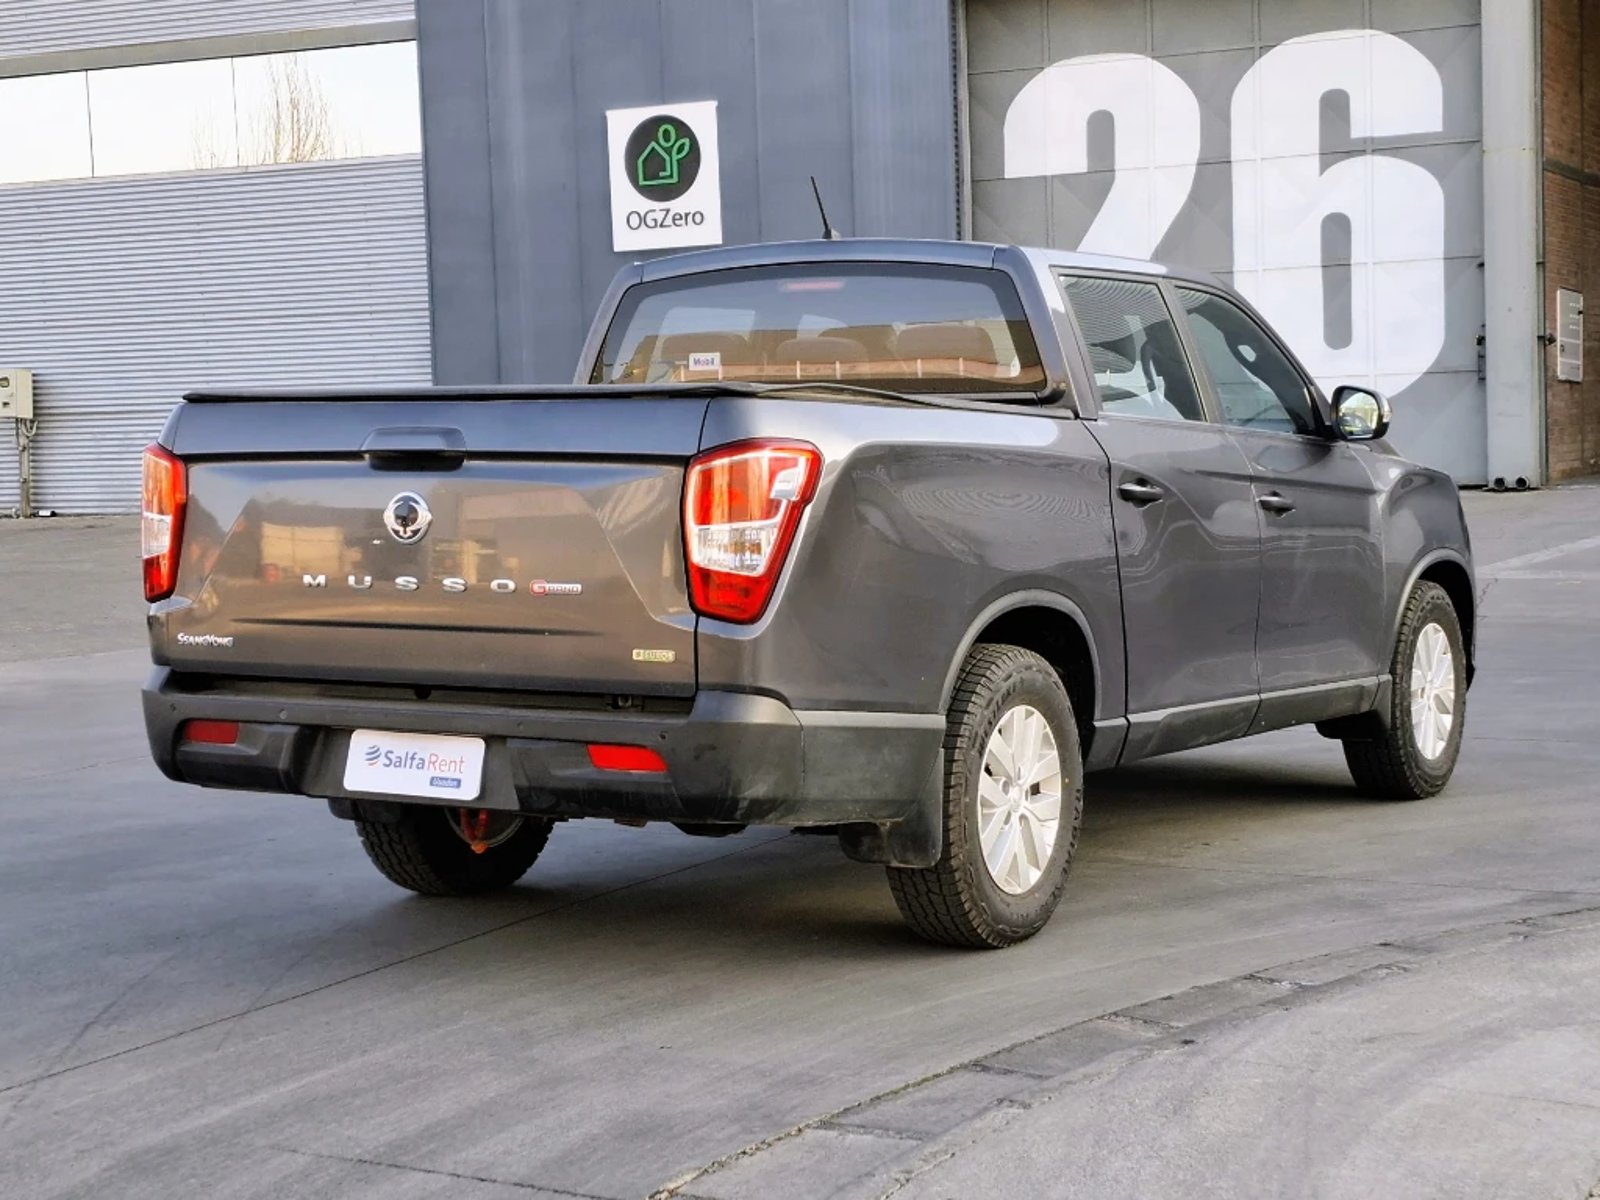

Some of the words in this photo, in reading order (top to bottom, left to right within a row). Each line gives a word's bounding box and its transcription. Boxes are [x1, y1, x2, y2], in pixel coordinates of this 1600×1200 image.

[626, 208, 704, 230] OGZero
[1004, 29, 1445, 399] 26
[303, 574, 517, 593] MUSSO
[382, 749, 464, 774] SalfaRent
